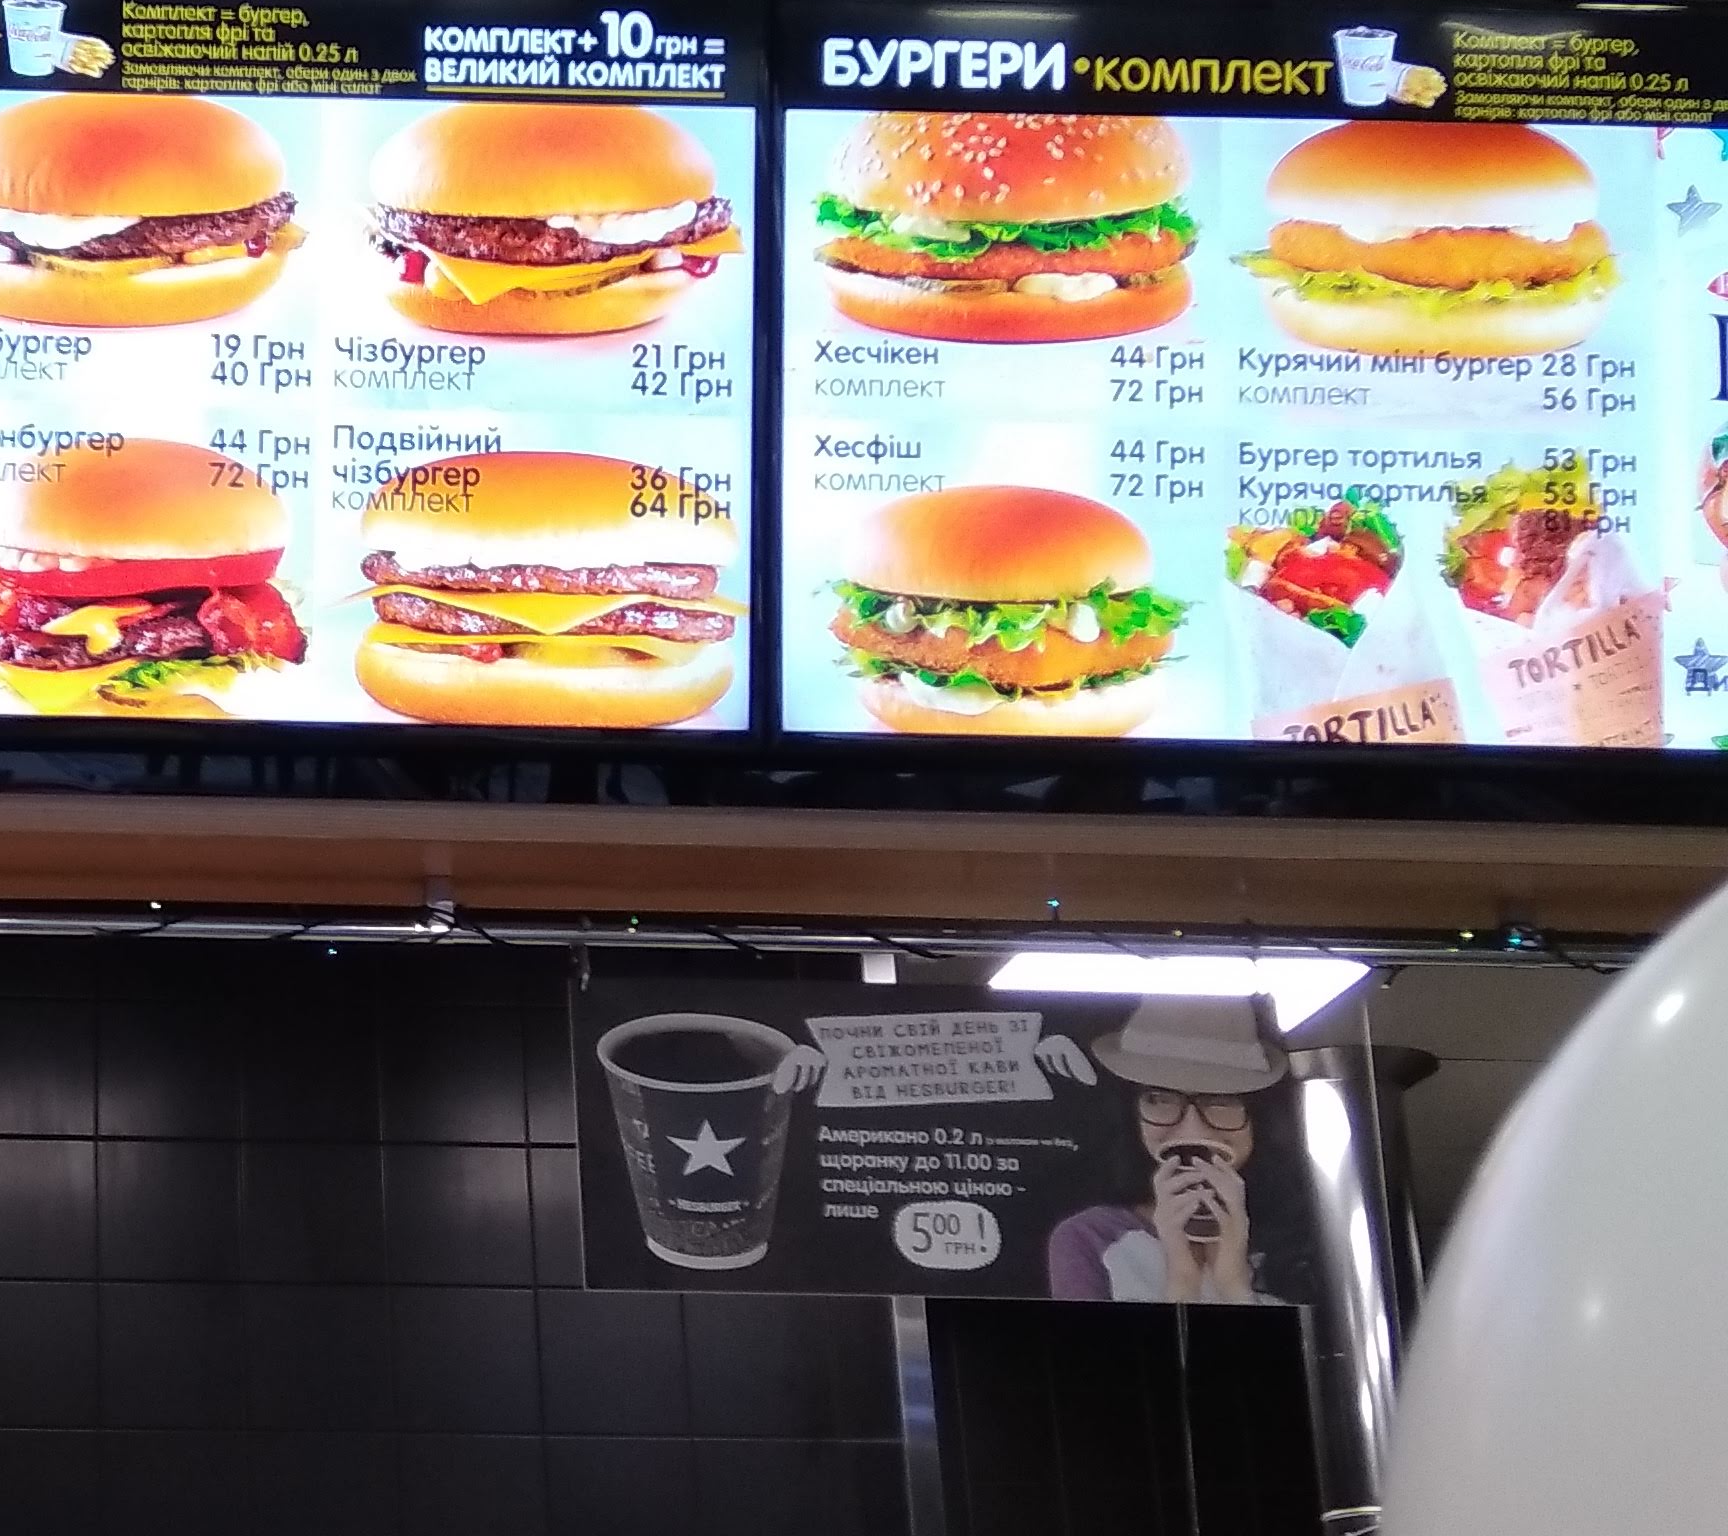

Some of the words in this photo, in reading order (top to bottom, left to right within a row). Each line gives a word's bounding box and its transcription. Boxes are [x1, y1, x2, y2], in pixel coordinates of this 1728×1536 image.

[122, 0, 215, 21] Комплект
[238, 3, 310, 27] бургер,
[122, 23, 212, 42] картопля
[216, 21, 250, 44] фрі
[254, 26, 276, 42] та
[1454, 31, 1546, 50] Комплект
[1570, 35, 1640, 57] бургер,
[122, 40, 237, 60] освіжаючий
[242, 40, 293, 61] напій
[299, 43, 340, 63] 0.25
[822, 37, 1066, 91] БУРГЕРИ
[1454, 53, 1544, 71] картопля
[1548, 50, 1580, 74] фрі
[1584, 56, 1606, 71] та
[424, 54, 561, 85] ВЕЛИКИЙ
[569, 61, 726, 89] КОМПЛЕКТ
[1454, 70, 1570, 89] освіжаючий
[1573, 72, 1626, 90] напій
[1630, 73, 1671, 92] 0.25
[210, 333, 241, 359] 19
[253, 334, 305, 365] Грн
[334, 336, 486, 372] Чізбургер
[631, 343, 662, 369] 21
[673, 345, 726, 375] Грн
[814, 339, 940, 365] Хесчікен
[1109, 345, 1147, 369] 44
[1156, 345, 1205, 375] Грн
[210, 361, 248, 386] 40
[259, 362, 312, 393] Грн
[1238, 347, 1361, 378] Курячий
[1371, 349, 1425, 375] міні
[1434, 349, 1533, 382] бургер
[1541, 353, 1578, 378] 28
[1587, 354, 1636, 384] Грн
[333, 368, 475, 391] комплект
[630, 372, 668, 396] 42
[680, 373, 733, 403] Грн
[814, 378, 945, 398] комплект
[1109, 378, 1144, 403] 72
[1155, 379, 1204, 409] Грн
[1238, 384, 1372, 406] комплект
[1541, 387, 1578, 411] 56
[1587, 387, 1636, 418] Грн
[209, 428, 247, 453] 44
[258, 429, 311, 459] Грн
[332, 423, 501, 455] Подвійний
[813, 434, 922, 465] Хесфіш
[1109, 439, 1147, 463] 44
[1156, 440, 1205, 470] Грн
[1238, 442, 1339, 474] Бургер
[1347, 447, 1482, 476] тортилья
[1587, 449, 1637, 480] Грн
[208, 462, 245, 489] 72
[256, 464, 309, 495] Грн
[332, 458, 481, 494] чізбургер
[630, 465, 668, 491] 36
[678, 466, 732, 498] Грн
[814, 473, 945, 493] комплект
[1109, 473, 1144, 497] 72
[1155, 473, 1204, 504] Грн
[331, 488, 474, 513] комплект
[629, 492, 668, 518] 64
[678, 493, 732, 525] Грн
[1238, 476, 1345, 506] Куряча
[1356, 482, 1489, 511] тортилья
[1542, 482, 1576, 506] 53
[1587, 482, 1638, 513] Грн
[1508, 618, 1641, 689] TORTILLA
[819, 1025, 883, 1041] ПОЧНИ
[894, 1020, 941, 1038] СВІЙ
[843, 1060, 959, 1080] АРОМАТНОЇ
[970, 1060, 1020, 1075] КАВИ
[852, 1086, 887, 1100] ВІД
[897, 1080, 1017, 1097] HESBURGER!
[819, 1125, 929, 1146] Американо
[934, 1128, 965, 1146] 0.2
[971, 1131, 983, 1146] л
[820, 1153, 909, 1173] щоранку
[915, 1157, 941, 1172] до
[944, 1153, 992, 1171] 11.00
[996, 1158, 1020, 1172] за
[822, 1176, 949, 1196] спеціальною
[954, 1178, 1013, 1198] ціною
[823, 1202, 879, 1219] лише
